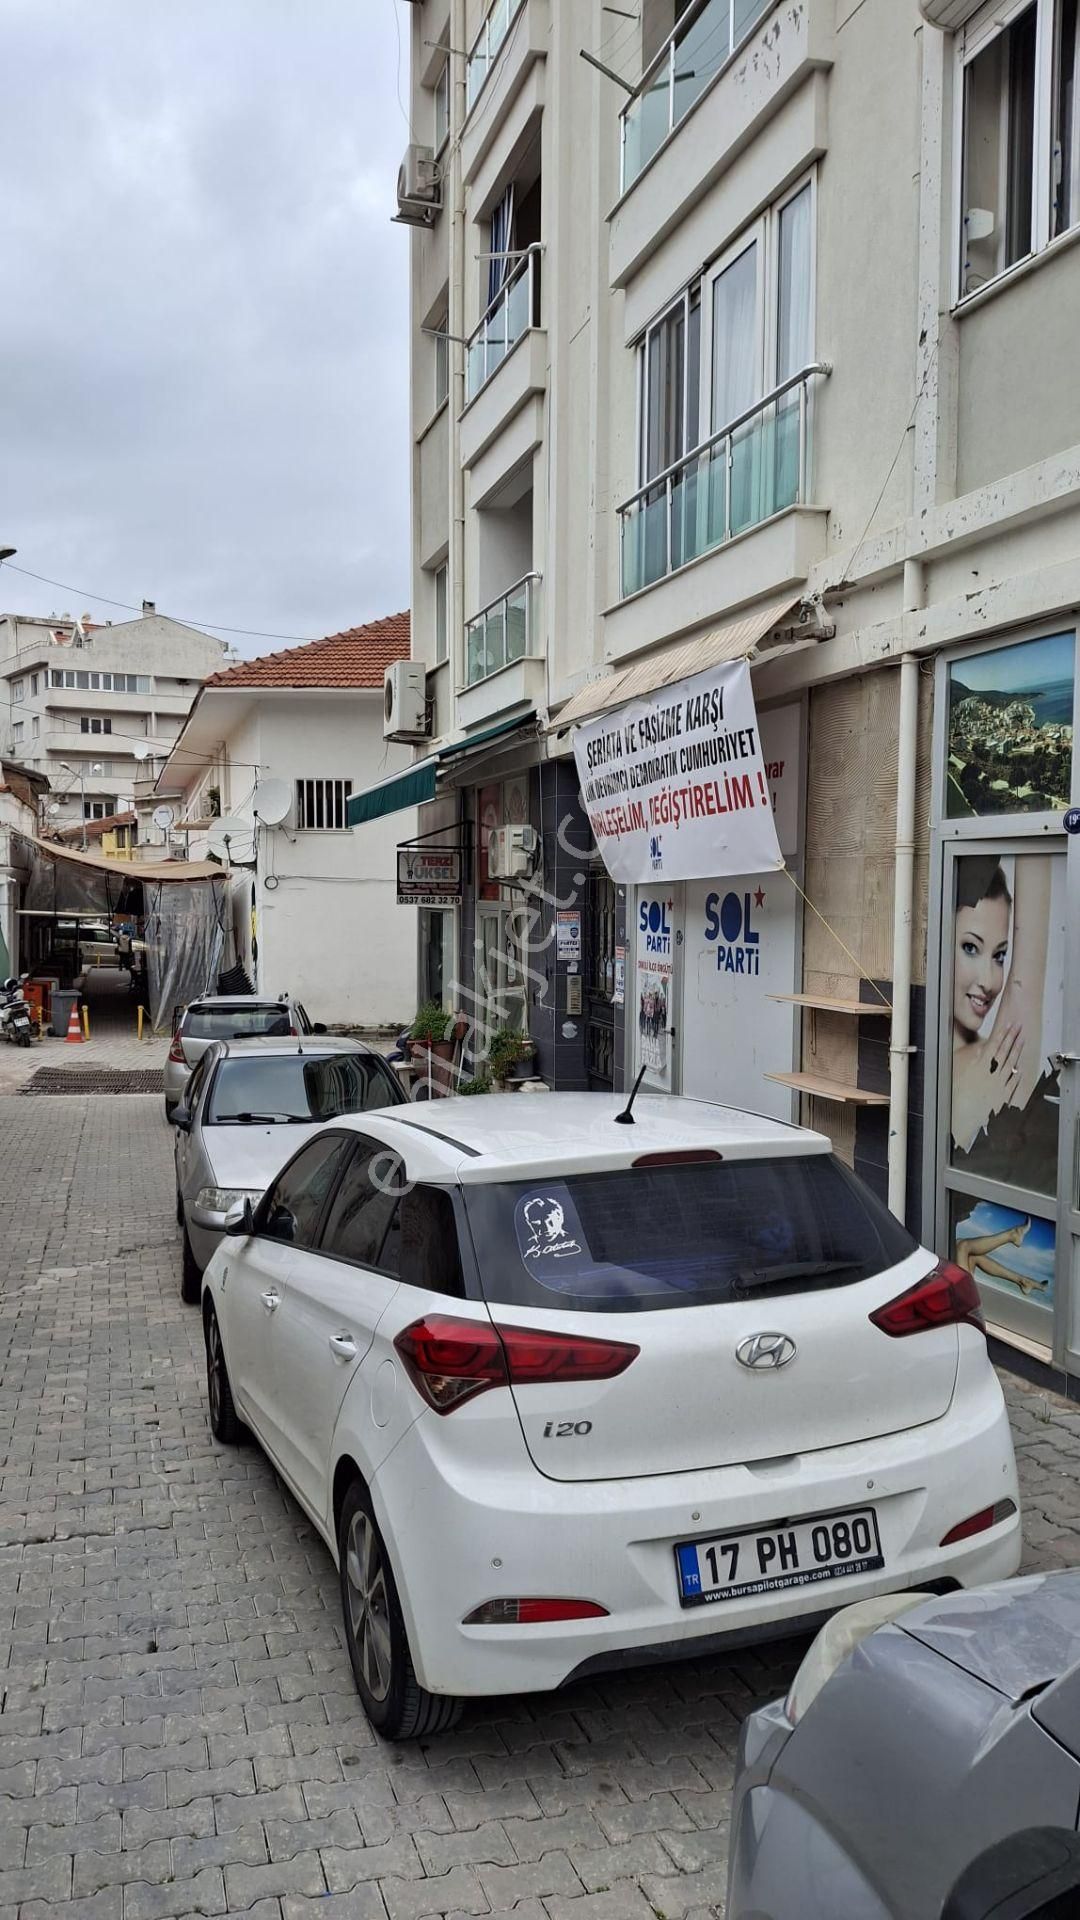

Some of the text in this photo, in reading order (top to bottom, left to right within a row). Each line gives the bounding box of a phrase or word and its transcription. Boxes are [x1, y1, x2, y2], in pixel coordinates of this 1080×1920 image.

[587, 687, 725, 776] ŞERİATA VE FAŞİZME KARŞI
[630, 747, 678, 789] DEMOKRATİK
[680, 728, 756, 773] CUMHURİYET
[399, 896, 419, 904] 0537
[438, 896, 448, 904] 32
[450, 896, 460, 904] 70
[640, 900, 671, 933] SOL
[704, 892, 760, 944] SOL
[543, 1420, 593, 1438] i20
[685, 1518, 872, 1585] TR 17 PH 080
[704, 1569, 831, 1602] www.bursapilotgarage.com
